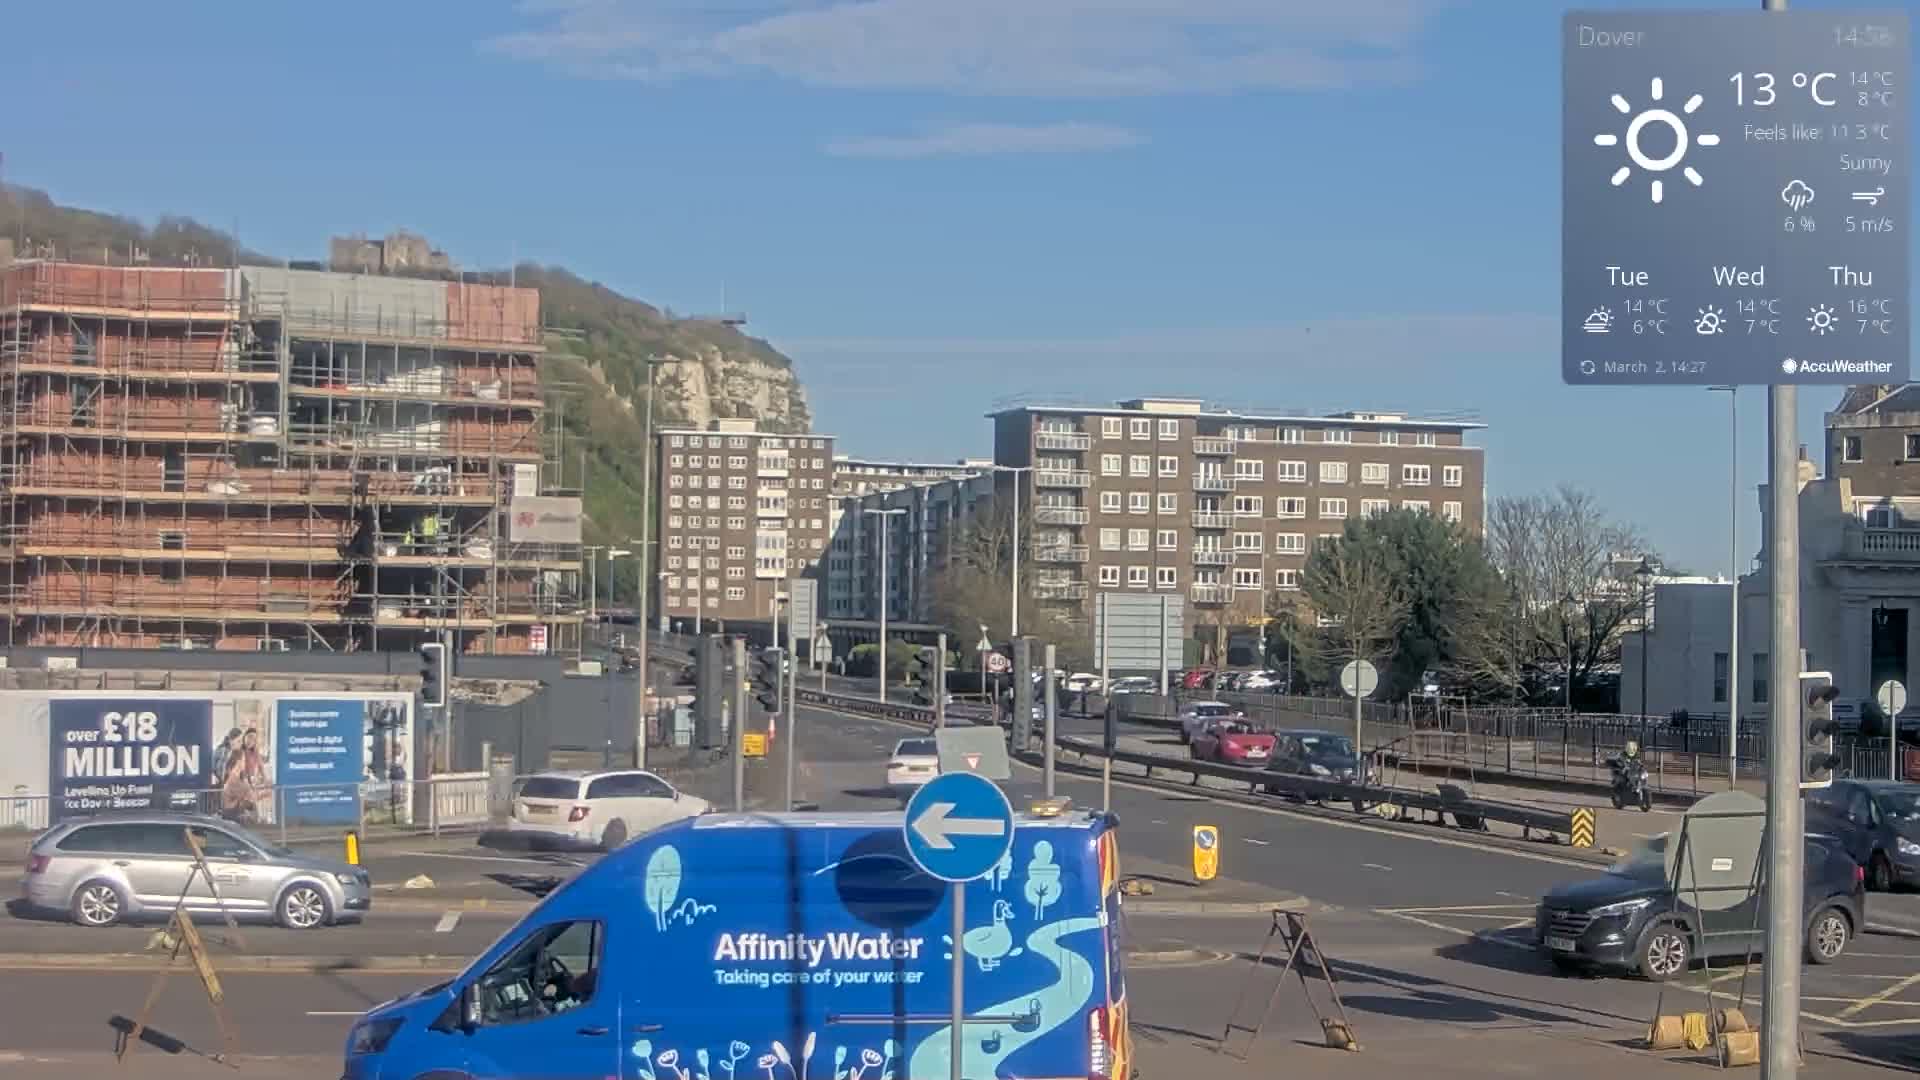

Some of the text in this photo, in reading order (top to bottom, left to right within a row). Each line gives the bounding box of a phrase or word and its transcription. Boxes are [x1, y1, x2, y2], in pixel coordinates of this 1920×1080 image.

[67, 711, 158, 742] over £18
[65, 745, 200, 777] MILLION
[81, 798, 109, 809] Dovr
[714, 969, 769, 988] Taking
[813, 969, 831, 984] of
[832, 971, 870, 988] your
[874, 971, 924, 984] waer
